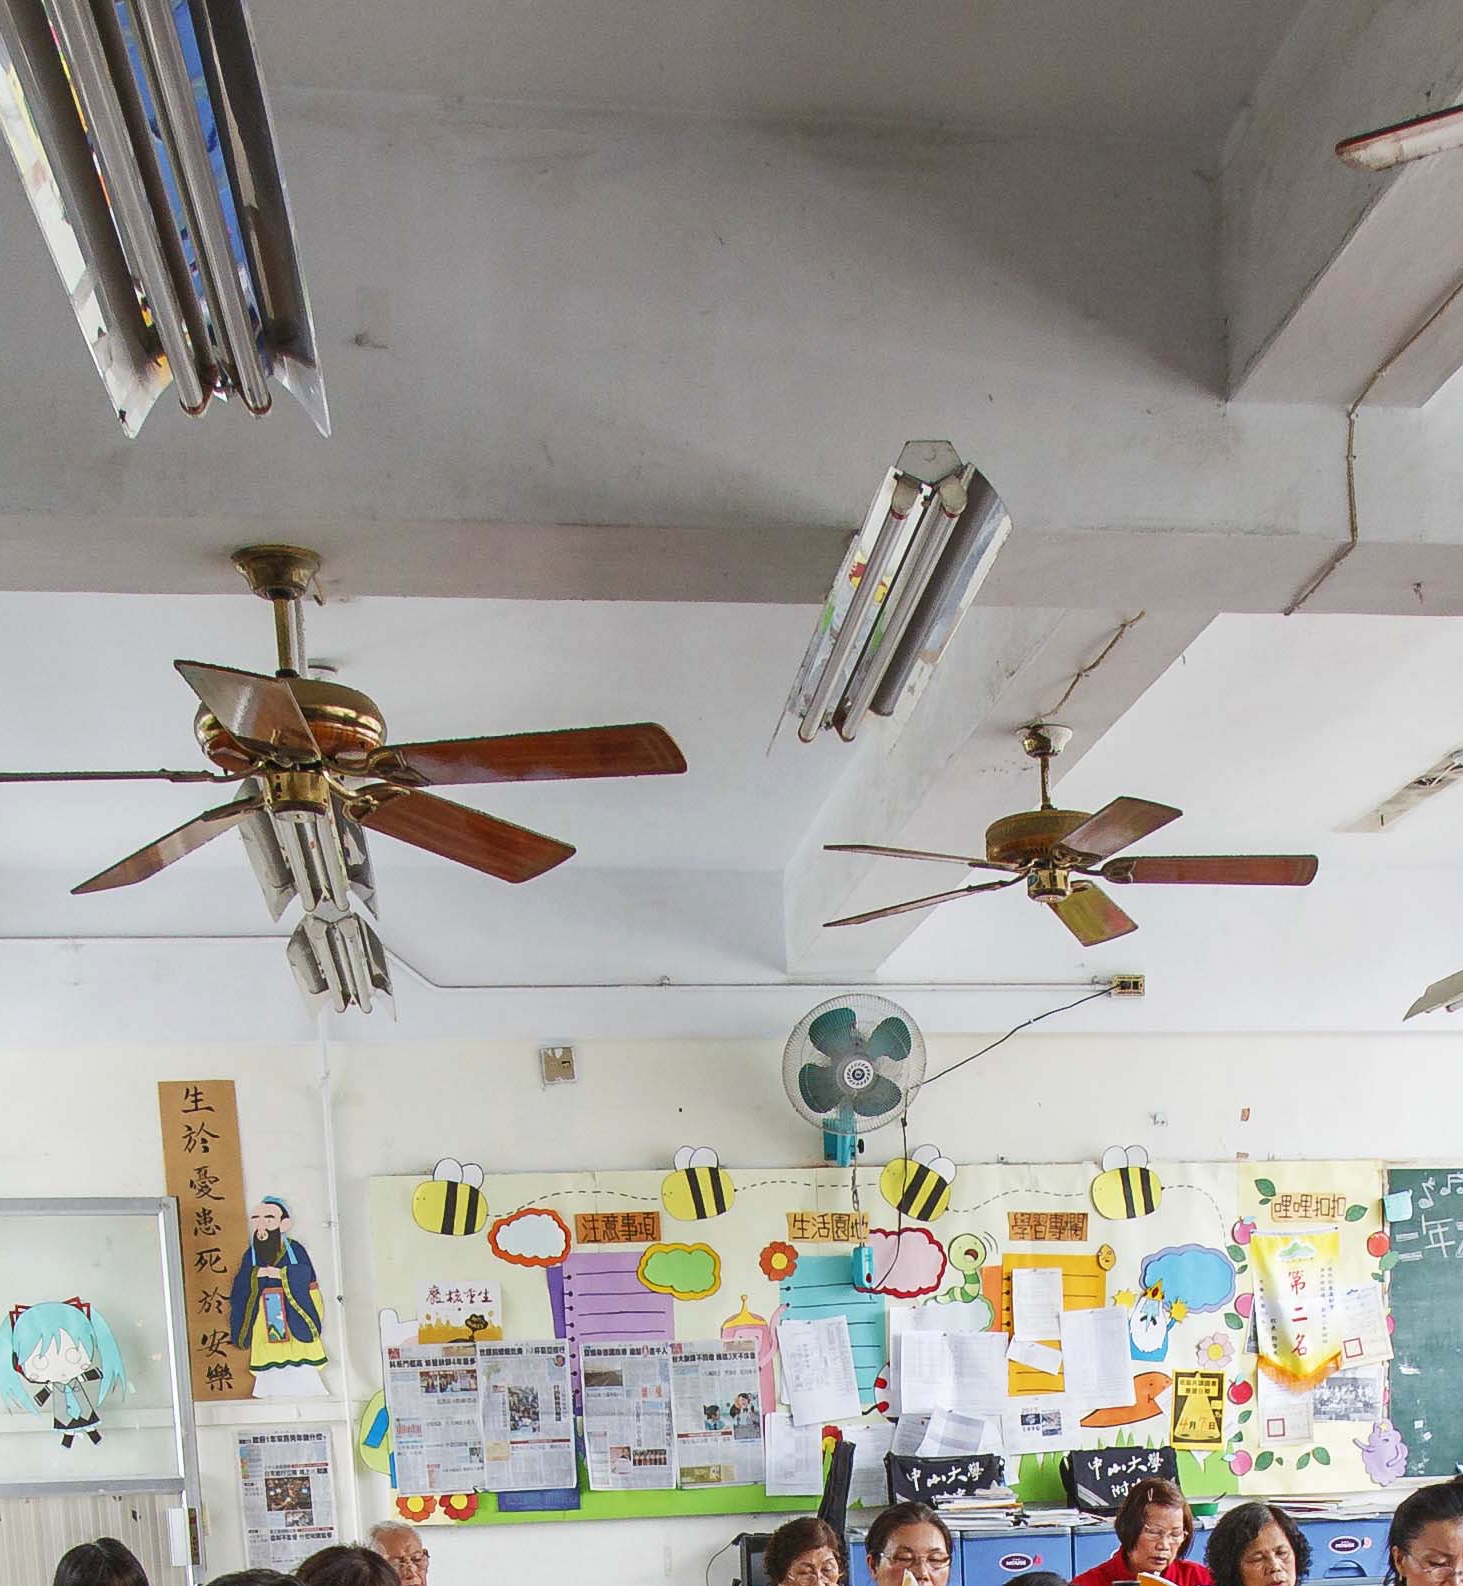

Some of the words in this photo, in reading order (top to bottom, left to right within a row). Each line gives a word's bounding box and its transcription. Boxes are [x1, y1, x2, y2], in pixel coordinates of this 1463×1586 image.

[181, 1085, 234, 1392] 生於憂患死於安樂
[581, 1213, 659, 1242] 注意事項
[791, 1213, 869, 1242] 生活園地
[1011, 1212, 1086, 1241] 學習專欄
[1288, 1269, 1308, 1357] 第二名
[906, 1461, 985, 1492] 中山大學
[1087, 1451, 1165, 1481] 中山大學
